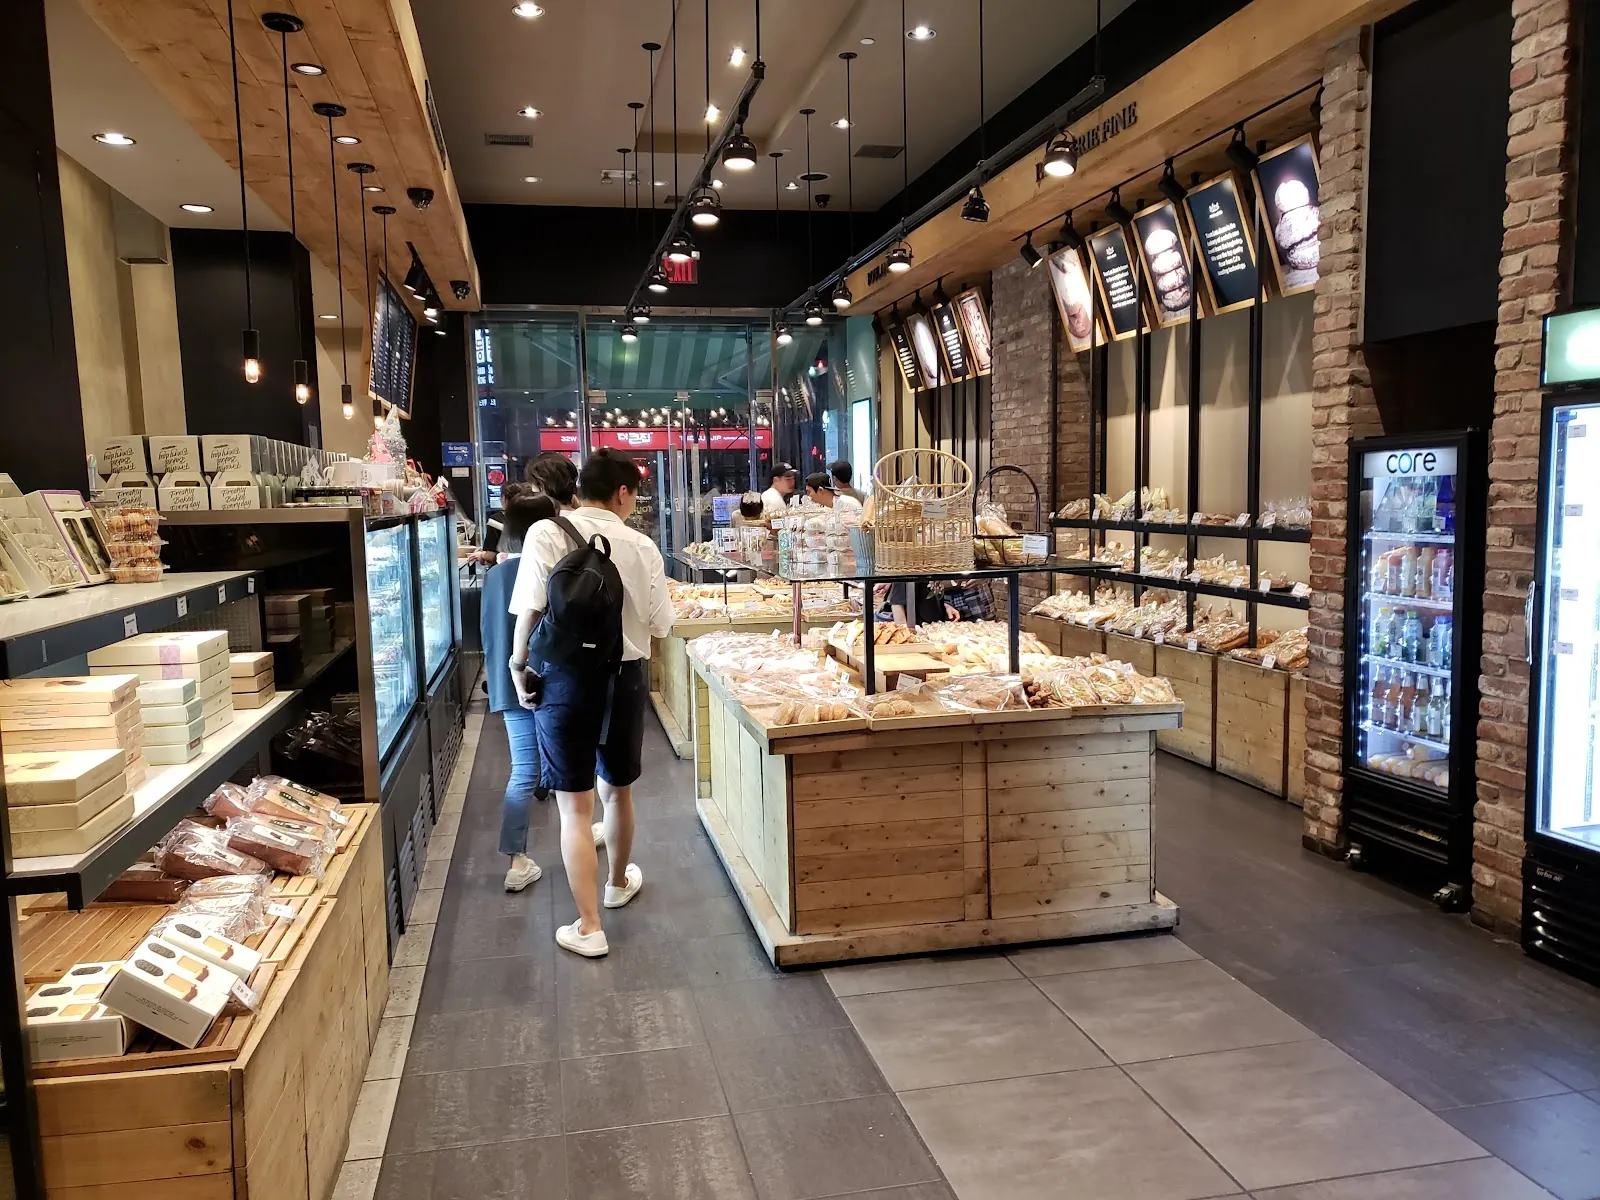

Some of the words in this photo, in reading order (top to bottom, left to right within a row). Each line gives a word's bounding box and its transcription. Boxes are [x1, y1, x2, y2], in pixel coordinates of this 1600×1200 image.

[1101, 101, 1138, 143] FINE
[664, 257, 694, 282] EXIT
[1386, 452, 1437, 474] core
[169, 488, 195, 499] Freshly
[222, 487, 247, 498] Freshly
[173, 495, 194, 504] Baked
[225, 494, 247, 503] Baked
[1535, 867, 1553, 879] Turbo
